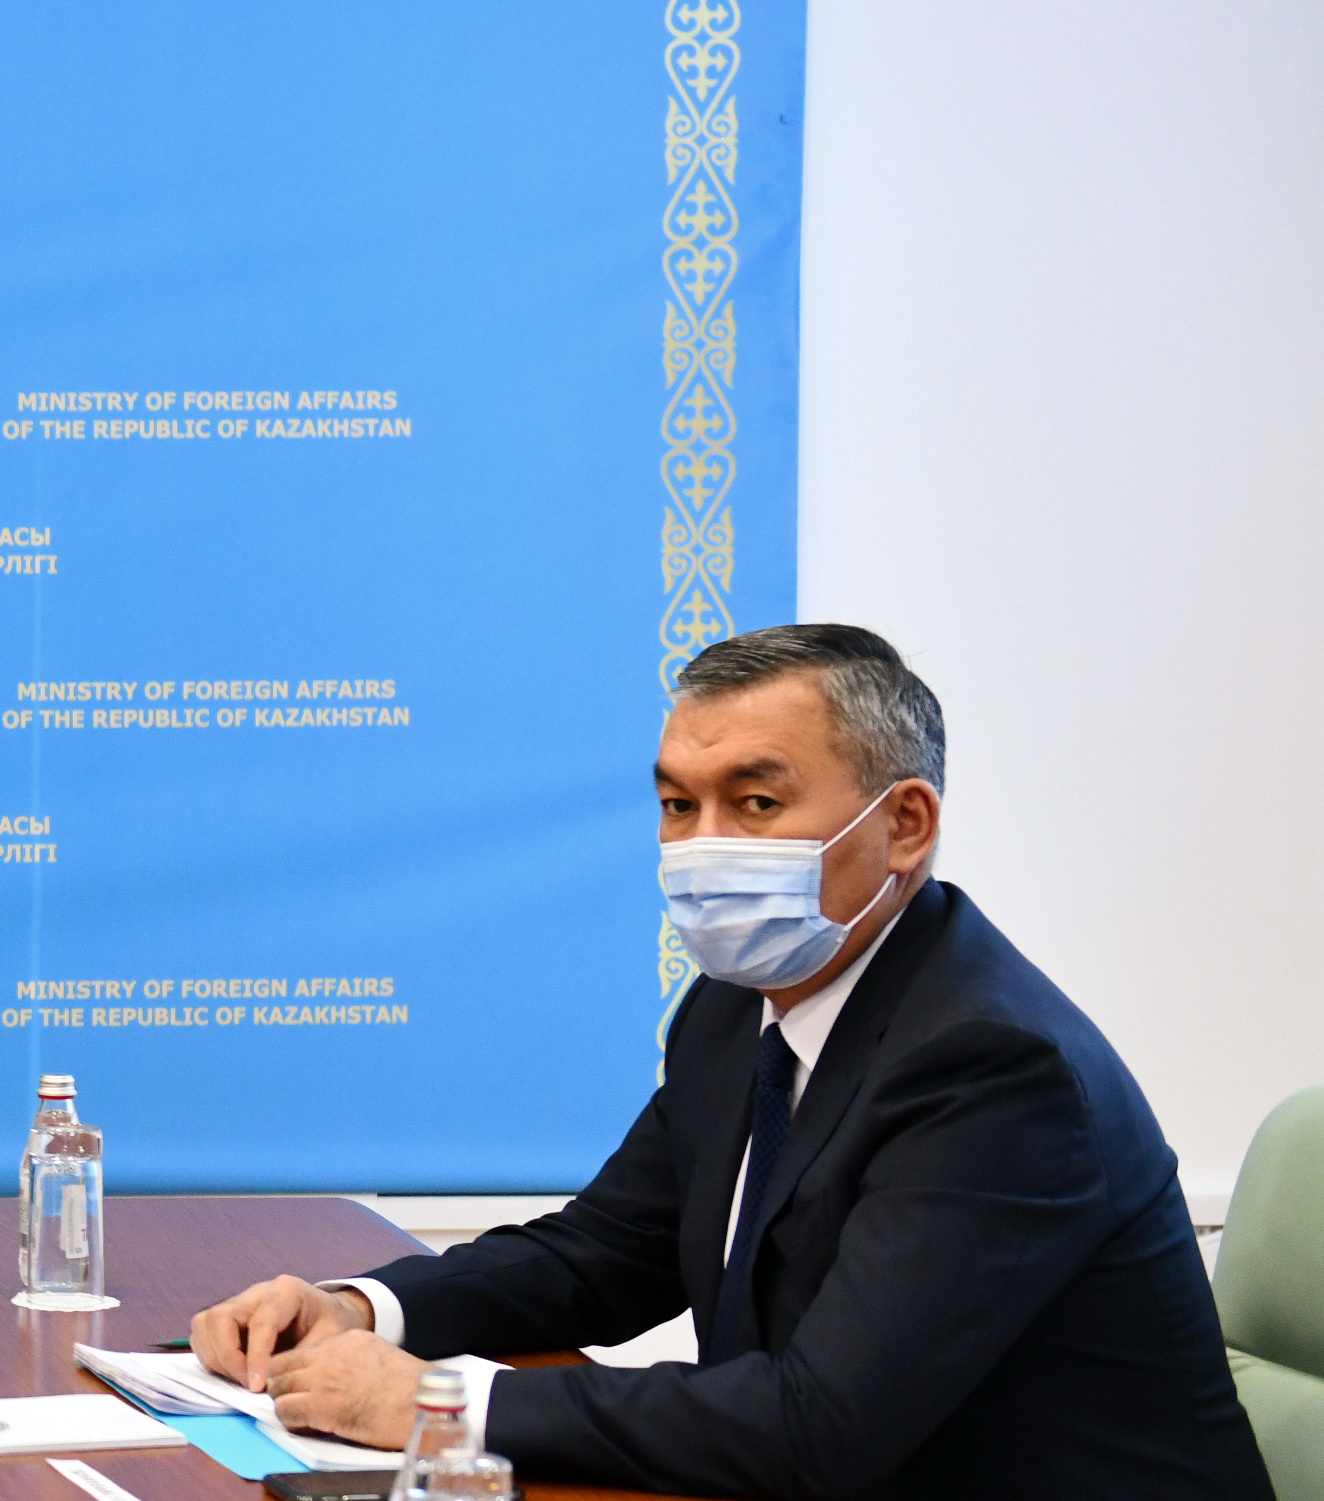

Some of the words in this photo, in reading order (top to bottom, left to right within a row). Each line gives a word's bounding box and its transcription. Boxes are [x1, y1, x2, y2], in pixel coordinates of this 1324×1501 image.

[17, 391, 139, 412] MINISTRY
[145, 391, 177, 412] OF
[183, 390, 291, 411] FOREIGN
[297, 390, 398, 411] AFFAIRS
[2, 419, 34, 440] OF
[40, 419, 86, 440] THE
[93, 418, 211, 440] REPUBLIC
[217, 418, 249, 439] OF
[255, 418, 412, 439] KAZAKHSTAN
[17, 681, 139, 702] MINISTRY
[144, 680, 176, 701] OF
[182, 680, 290, 701] FOREIGN
[295, 679, 397, 700] AFFAIRS
[1, 709, 34, 730] OF
[39, 709, 85, 730] THE
[92, 708, 211, 729] REPUBLIC
[216, 707, 248, 728] OF
[254, 706, 411, 728] KAZAKHSTAN
[16, 980, 137, 1001] MINISTRY
[143, 979, 175, 1000] OF
[181, 978, 289, 999] FOREIGN
[294, 977, 395, 998] AFFAIRS
[1, 1008, 33, 1029] OF
[38, 1007, 85, 1028] THE
[91, 1006, 209, 1028] REPUBLIC
[215, 1006, 247, 1027] OF
[253, 1004, 409, 1026] KAZAKHSTAN
